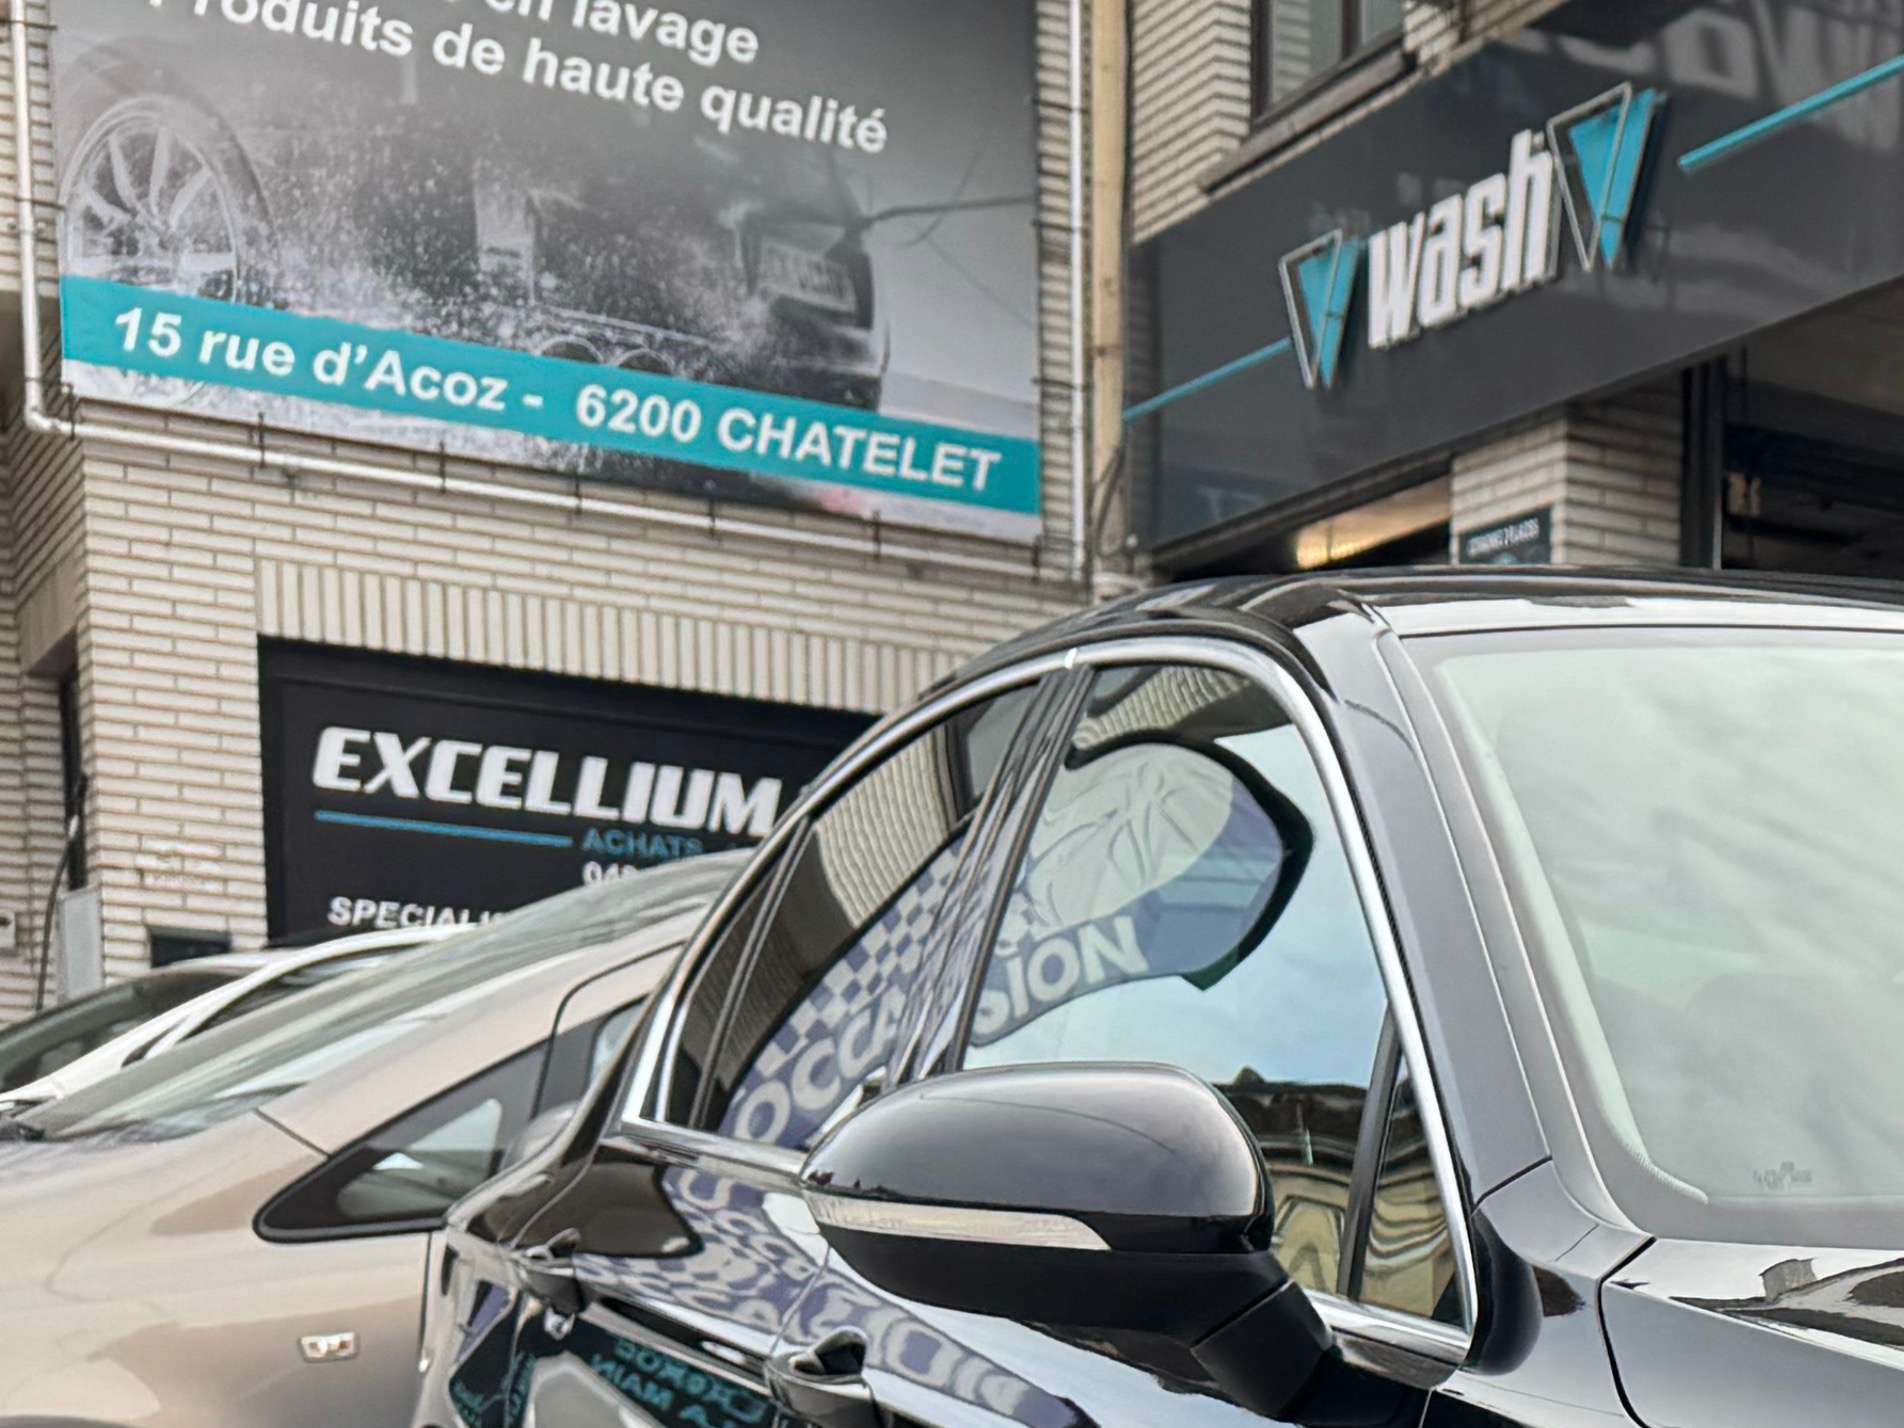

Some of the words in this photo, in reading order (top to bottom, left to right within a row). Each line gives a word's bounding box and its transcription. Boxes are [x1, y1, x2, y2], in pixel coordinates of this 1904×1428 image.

[151, 0, 415, 57] oduits
[431, 23, 506, 75] de
[522, 38, 686, 112] haute
[700, 83, 889, 153] qualité
[571, 0, 759, 67] lavage
[1367, 128, 1560, 349] wash
[112, 306, 184, 359] 15
[201, 329, 297, 377] rue
[312, 343, 508, 411] d’Acoz
[574, 384, 703, 443] 6200
[716, 407, 1002, 491] CHATELET
[312, 726, 784, 838] EXCELLIUM
[582, 827, 704, 857] ACHATS
